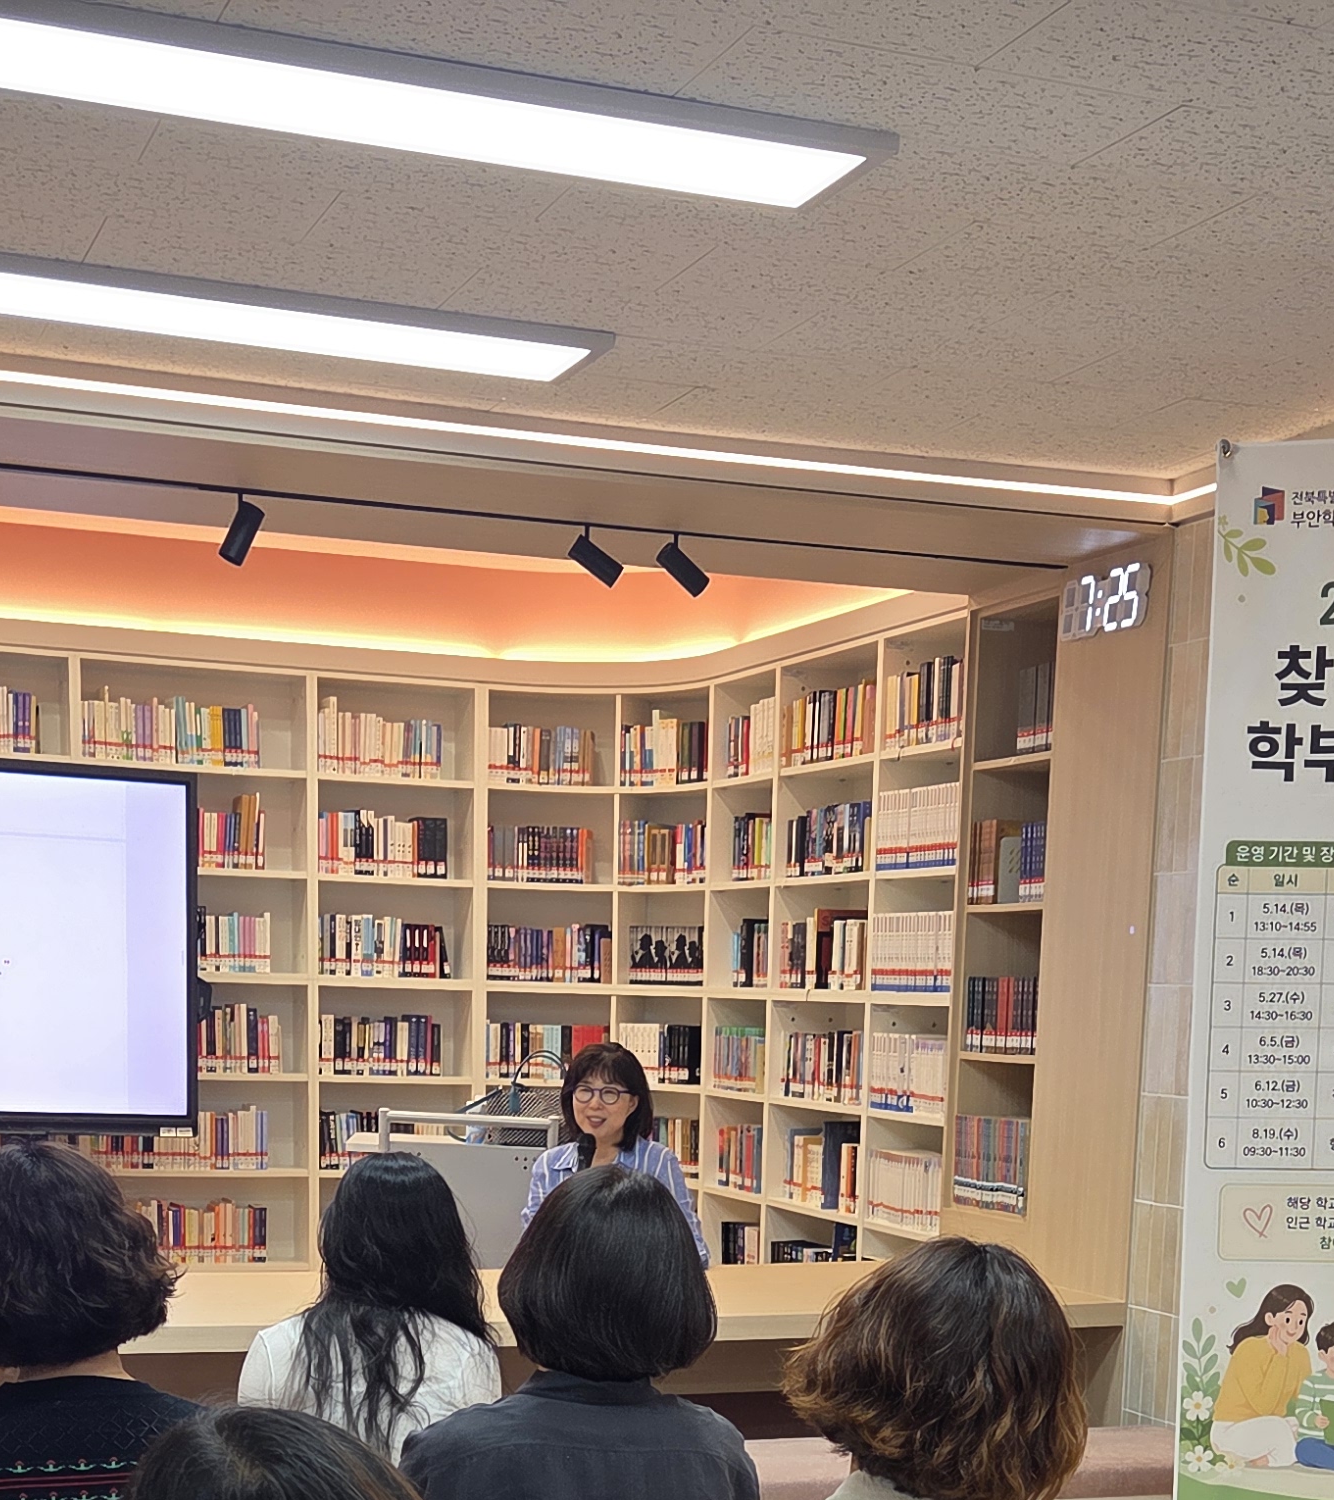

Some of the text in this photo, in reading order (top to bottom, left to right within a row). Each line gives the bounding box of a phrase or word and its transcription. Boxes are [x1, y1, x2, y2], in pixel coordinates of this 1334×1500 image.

[1081, 562, 1140, 632] 7:25
[1236, 845, 1264, 862] 운영
[1269, 846, 1298, 862] 기간
[1302, 846, 1316, 863] 및
[1227, 874, 1239, 887] 순
[1229, 911, 1234, 922] 1
[1226, 955, 1233, 966] 2
[1258, 992, 1305, 1004] 5.27.(수)
[1224, 1000, 1231, 1011] 3
[1259, 1036, 1300, 1048] 6.5.(금)
[1222, 1044, 1230, 1055] 4
[1220, 1088, 1228, 1099] 5
[1218, 1138, 1226, 1148] 6
[1287, 1196, 1311, 1210] 해당
[1286, 1216, 1310, 1230] 인근
